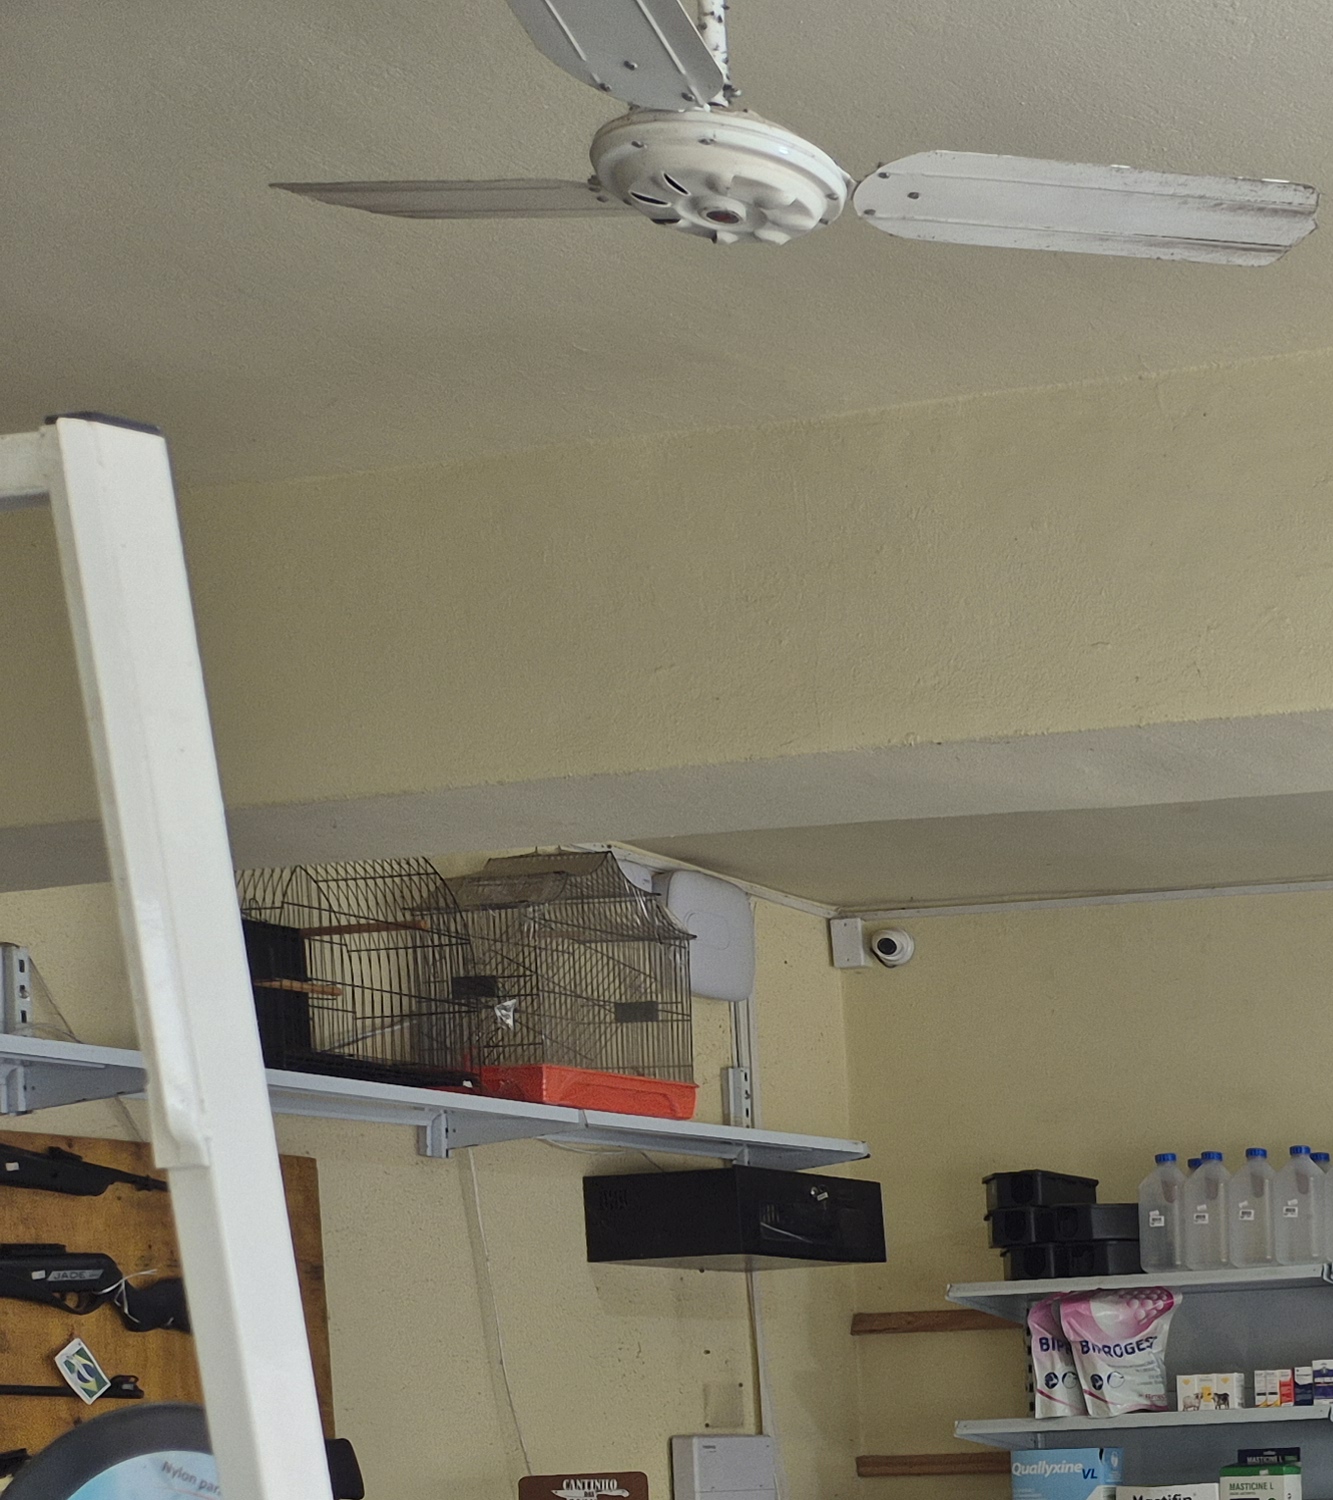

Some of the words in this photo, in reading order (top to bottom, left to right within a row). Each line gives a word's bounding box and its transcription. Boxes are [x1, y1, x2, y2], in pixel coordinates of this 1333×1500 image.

[1012, 1461, 1083, 1477] Quallyxine
[1082, 1468, 1099, 1480] VL
[162, 1461, 197, 1484] Nylon
[199, 1479, 220, 1497] par
[562, 1479, 618, 1491] CANTINHO
[1229, 1482, 1266, 1491] MASTICINE
